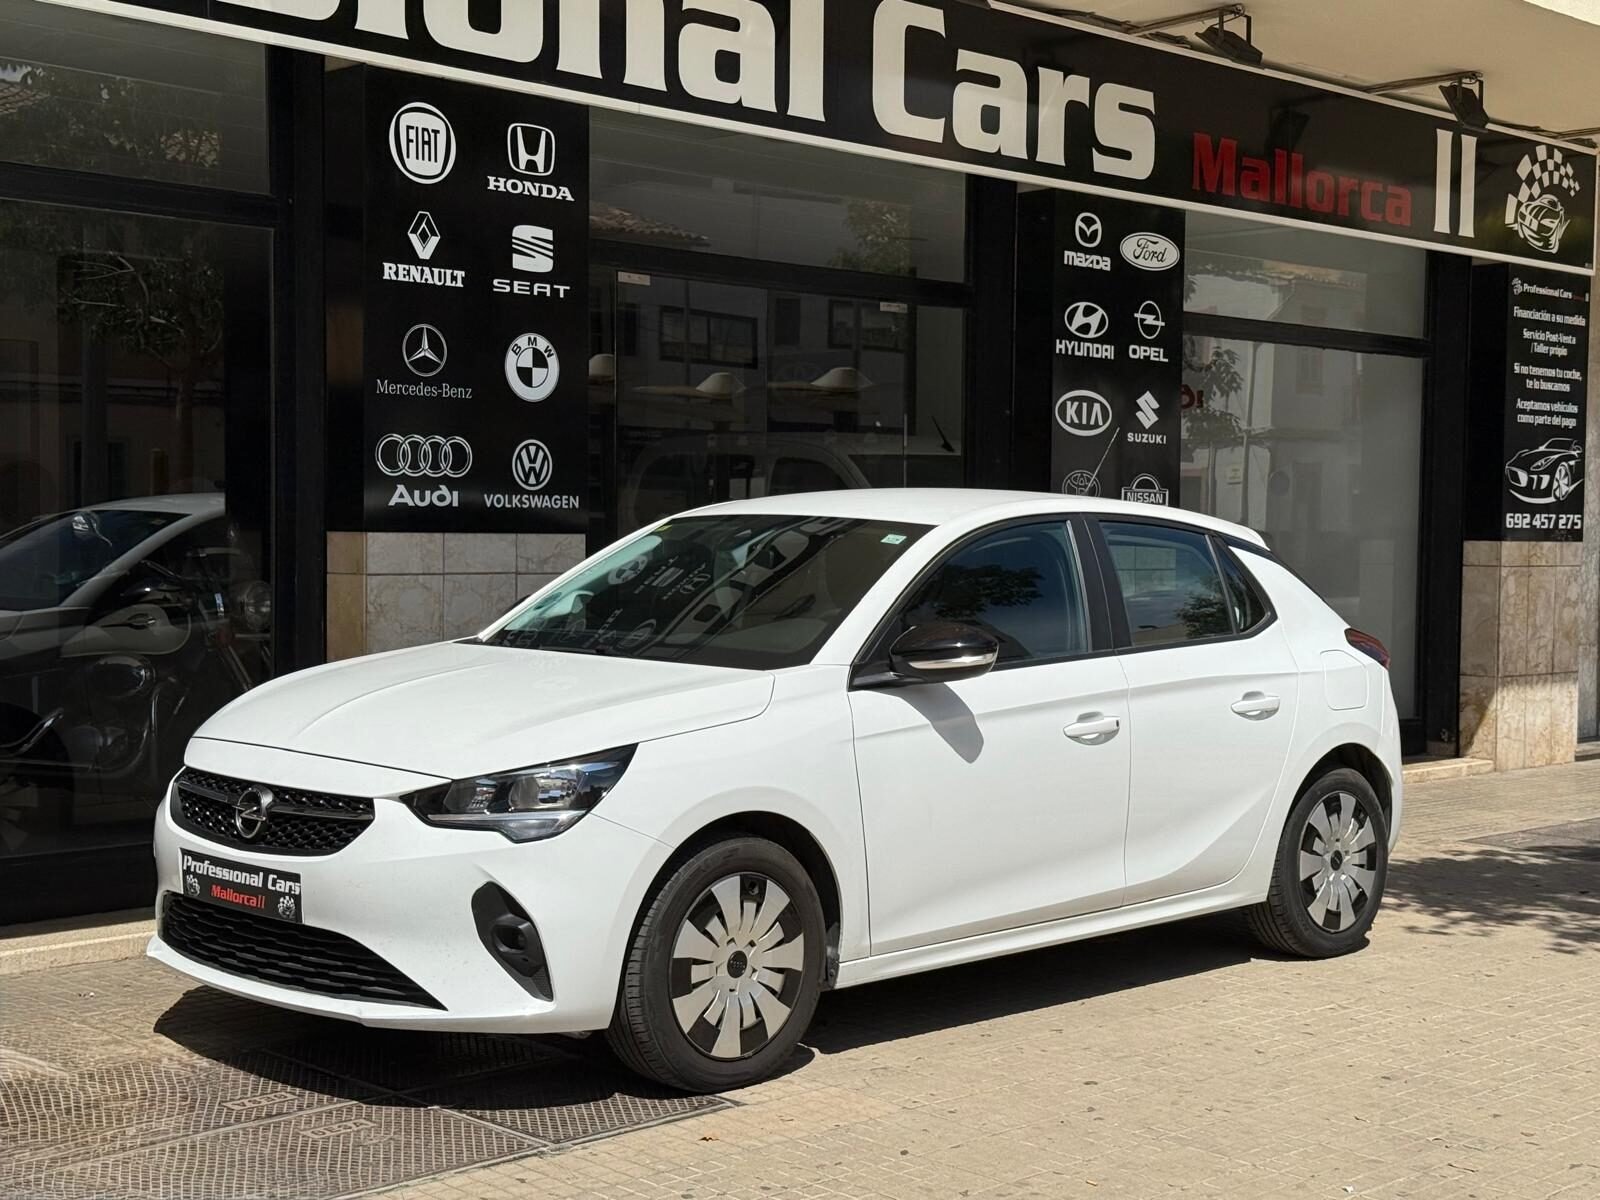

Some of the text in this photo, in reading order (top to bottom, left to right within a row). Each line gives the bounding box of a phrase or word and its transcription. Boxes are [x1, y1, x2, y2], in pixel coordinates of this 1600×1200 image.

[213, 0, 826, 122] onal
[872, 0, 1155, 180] Cars
[1192, 132, 1412, 226] Mallorca
[405, 125, 441, 164] FIAT
[487, 176, 575, 202] HONDA
[1133, 238, 1168, 263] Ford
[382, 262, 466, 288] RENAULT
[493, 279, 571, 299] SEAT
[1523, 283, 1560, 298] Professional
[1560, 289, 1573, 299] Cars
[1523, 328, 1546, 341] Servicio
[1055, 339, 1115, 361] HYUNDAI
[1128, 345, 1169, 363] OPEL
[1520, 365, 1529, 375] no
[1529, 365, 1556, 378] tenemos
[376, 379, 473, 399] Mercedes-Benz
[1526, 379, 1533, 389] te
[1540, 379, 1570, 393] buscamos
[1066, 400, 1104, 426] KIA
[1516, 398, 1550, 412] Aceptamos
[1517, 414, 1534, 424] como
[1534, 415, 1552, 427] parte
[1552, 415, 1561, 426] del
[1127, 432, 1167, 445] SUZUKI
[388, 484, 460, 508] Audi
[484, 494, 580, 509] VOLKSWAGEN
[1126, 492, 1164, 504] NISSAN
[1505, 512, 1582, 529] 692 457 275
[183, 855, 301, 896] Professional Cars
[210, 884, 257, 908] Mallorca
